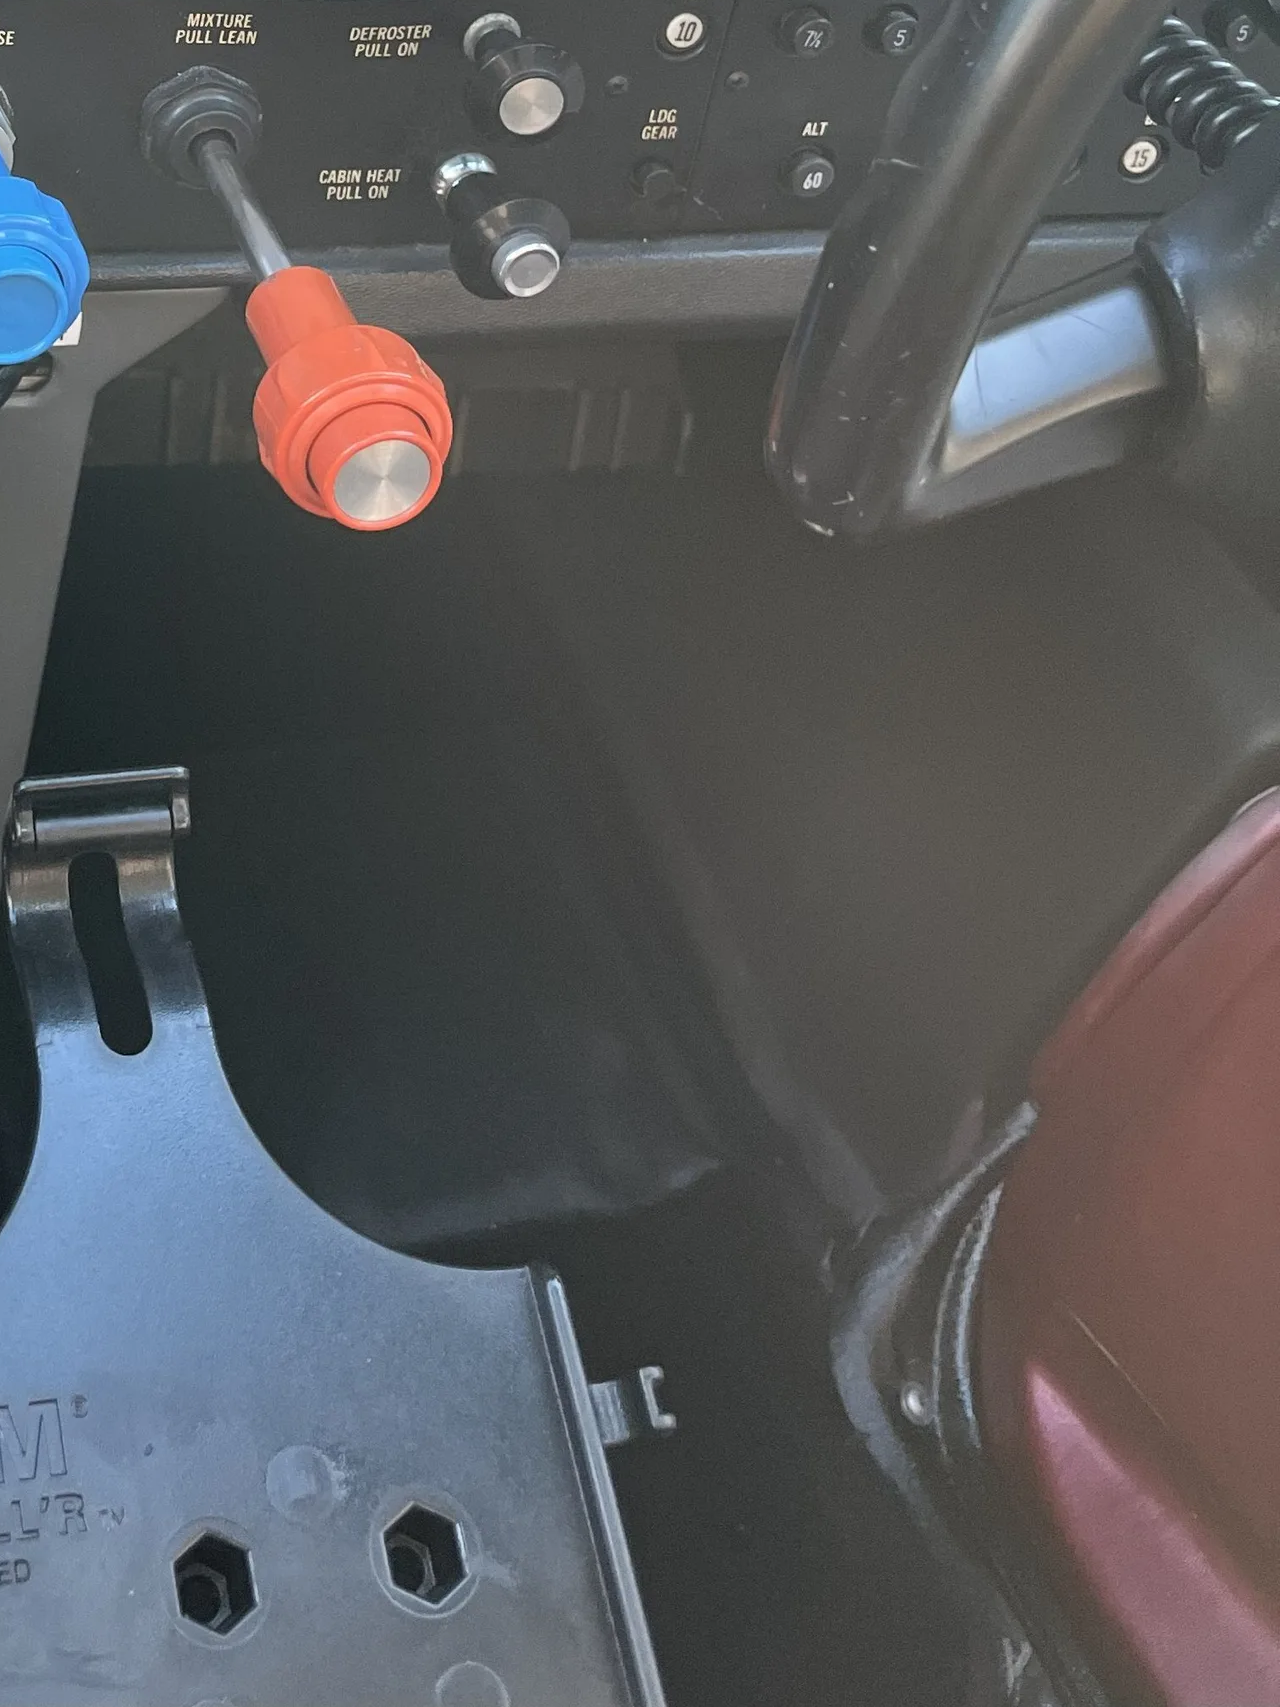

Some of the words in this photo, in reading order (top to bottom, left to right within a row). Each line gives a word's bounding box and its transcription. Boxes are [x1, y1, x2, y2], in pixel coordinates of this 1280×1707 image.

[187, 13, 253, 28] MIXTURE
[175, 30, 212, 44] PULL
[219, 30, 257, 44] LEAN
[349, 24, 432, 41] DEFROSTER
[642, 125, 678, 140] GEAR
[319, 169, 362, 184] CABIN
[366, 169, 401, 183] HEAT
